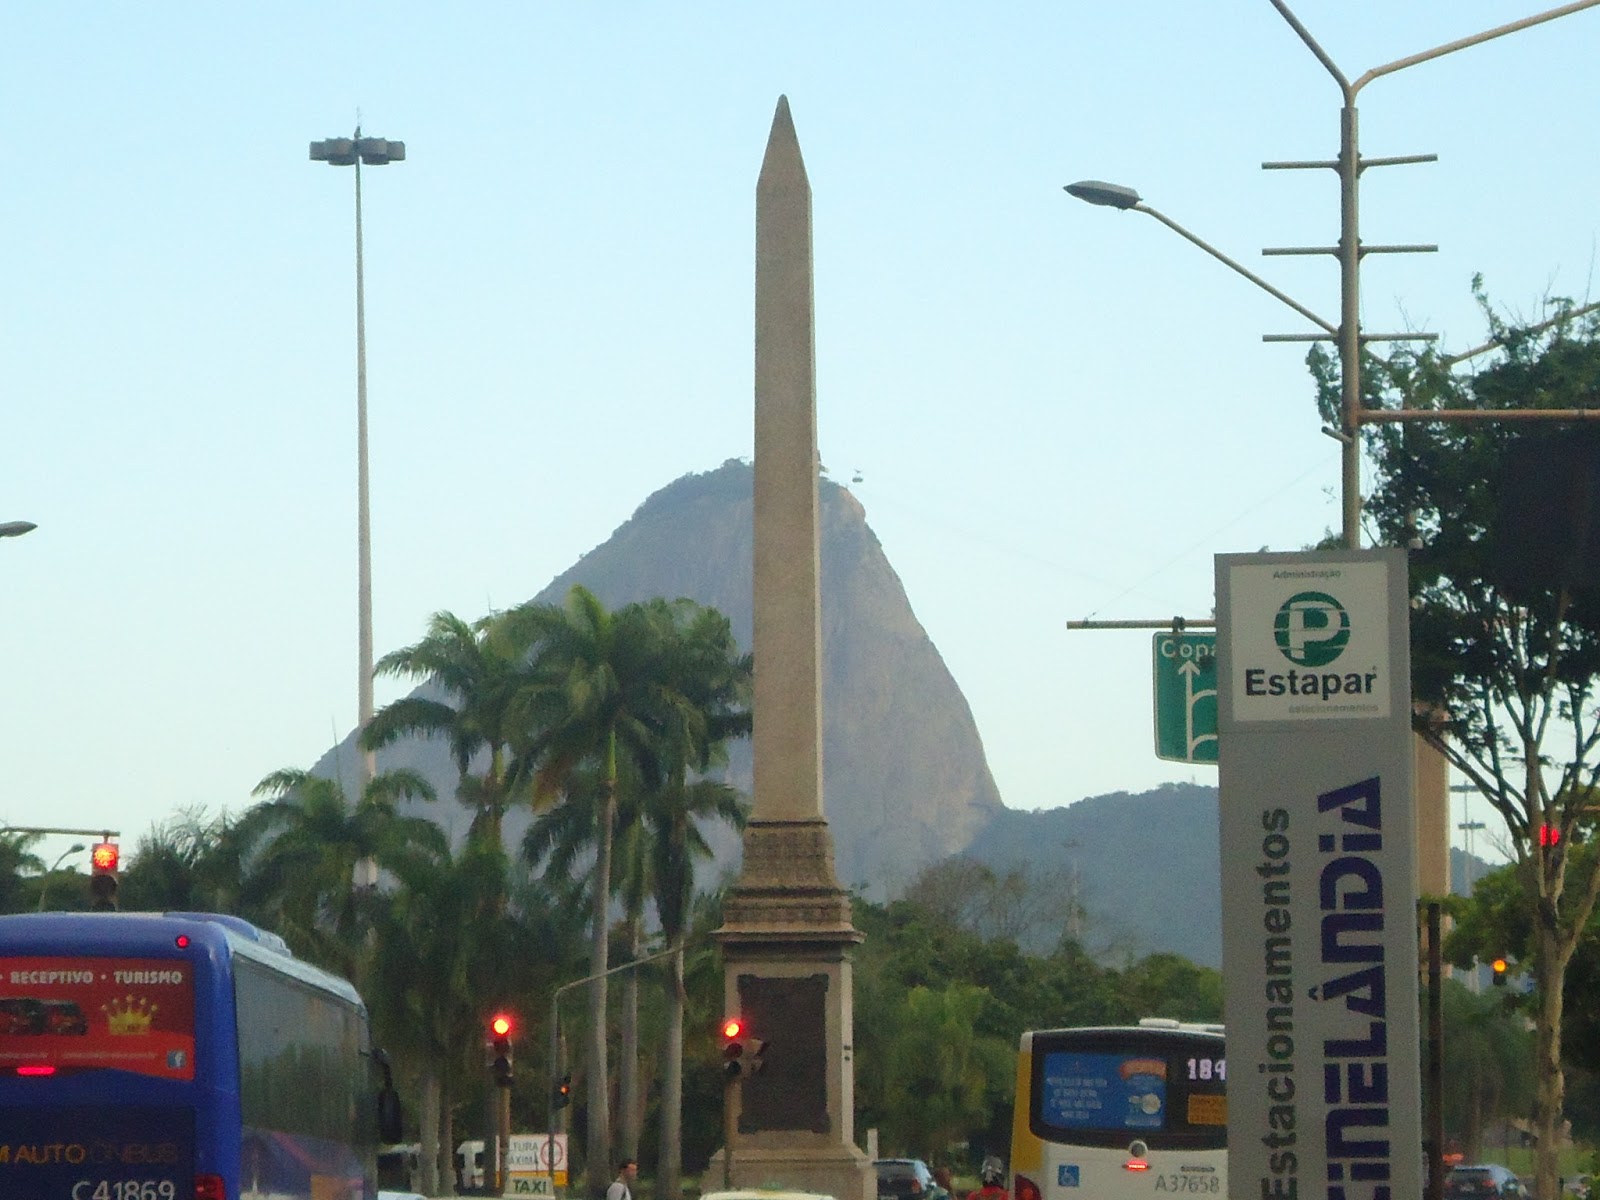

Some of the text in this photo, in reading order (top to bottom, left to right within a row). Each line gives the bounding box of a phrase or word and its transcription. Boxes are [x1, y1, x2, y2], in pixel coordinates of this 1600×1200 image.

[1246, 669, 1377, 700] Estapar
[10, 971, 183, 984] RECEPTIVO TURISMO
[1258, 807, 1298, 1200] Estacionamentos
[14, 1143, 86, 1164] AUTO
[71, 1179, 175, 1200] C41869
[513, 1179, 547, 1194] TAXI
[1155, 1174, 1220, 1193] A37658
